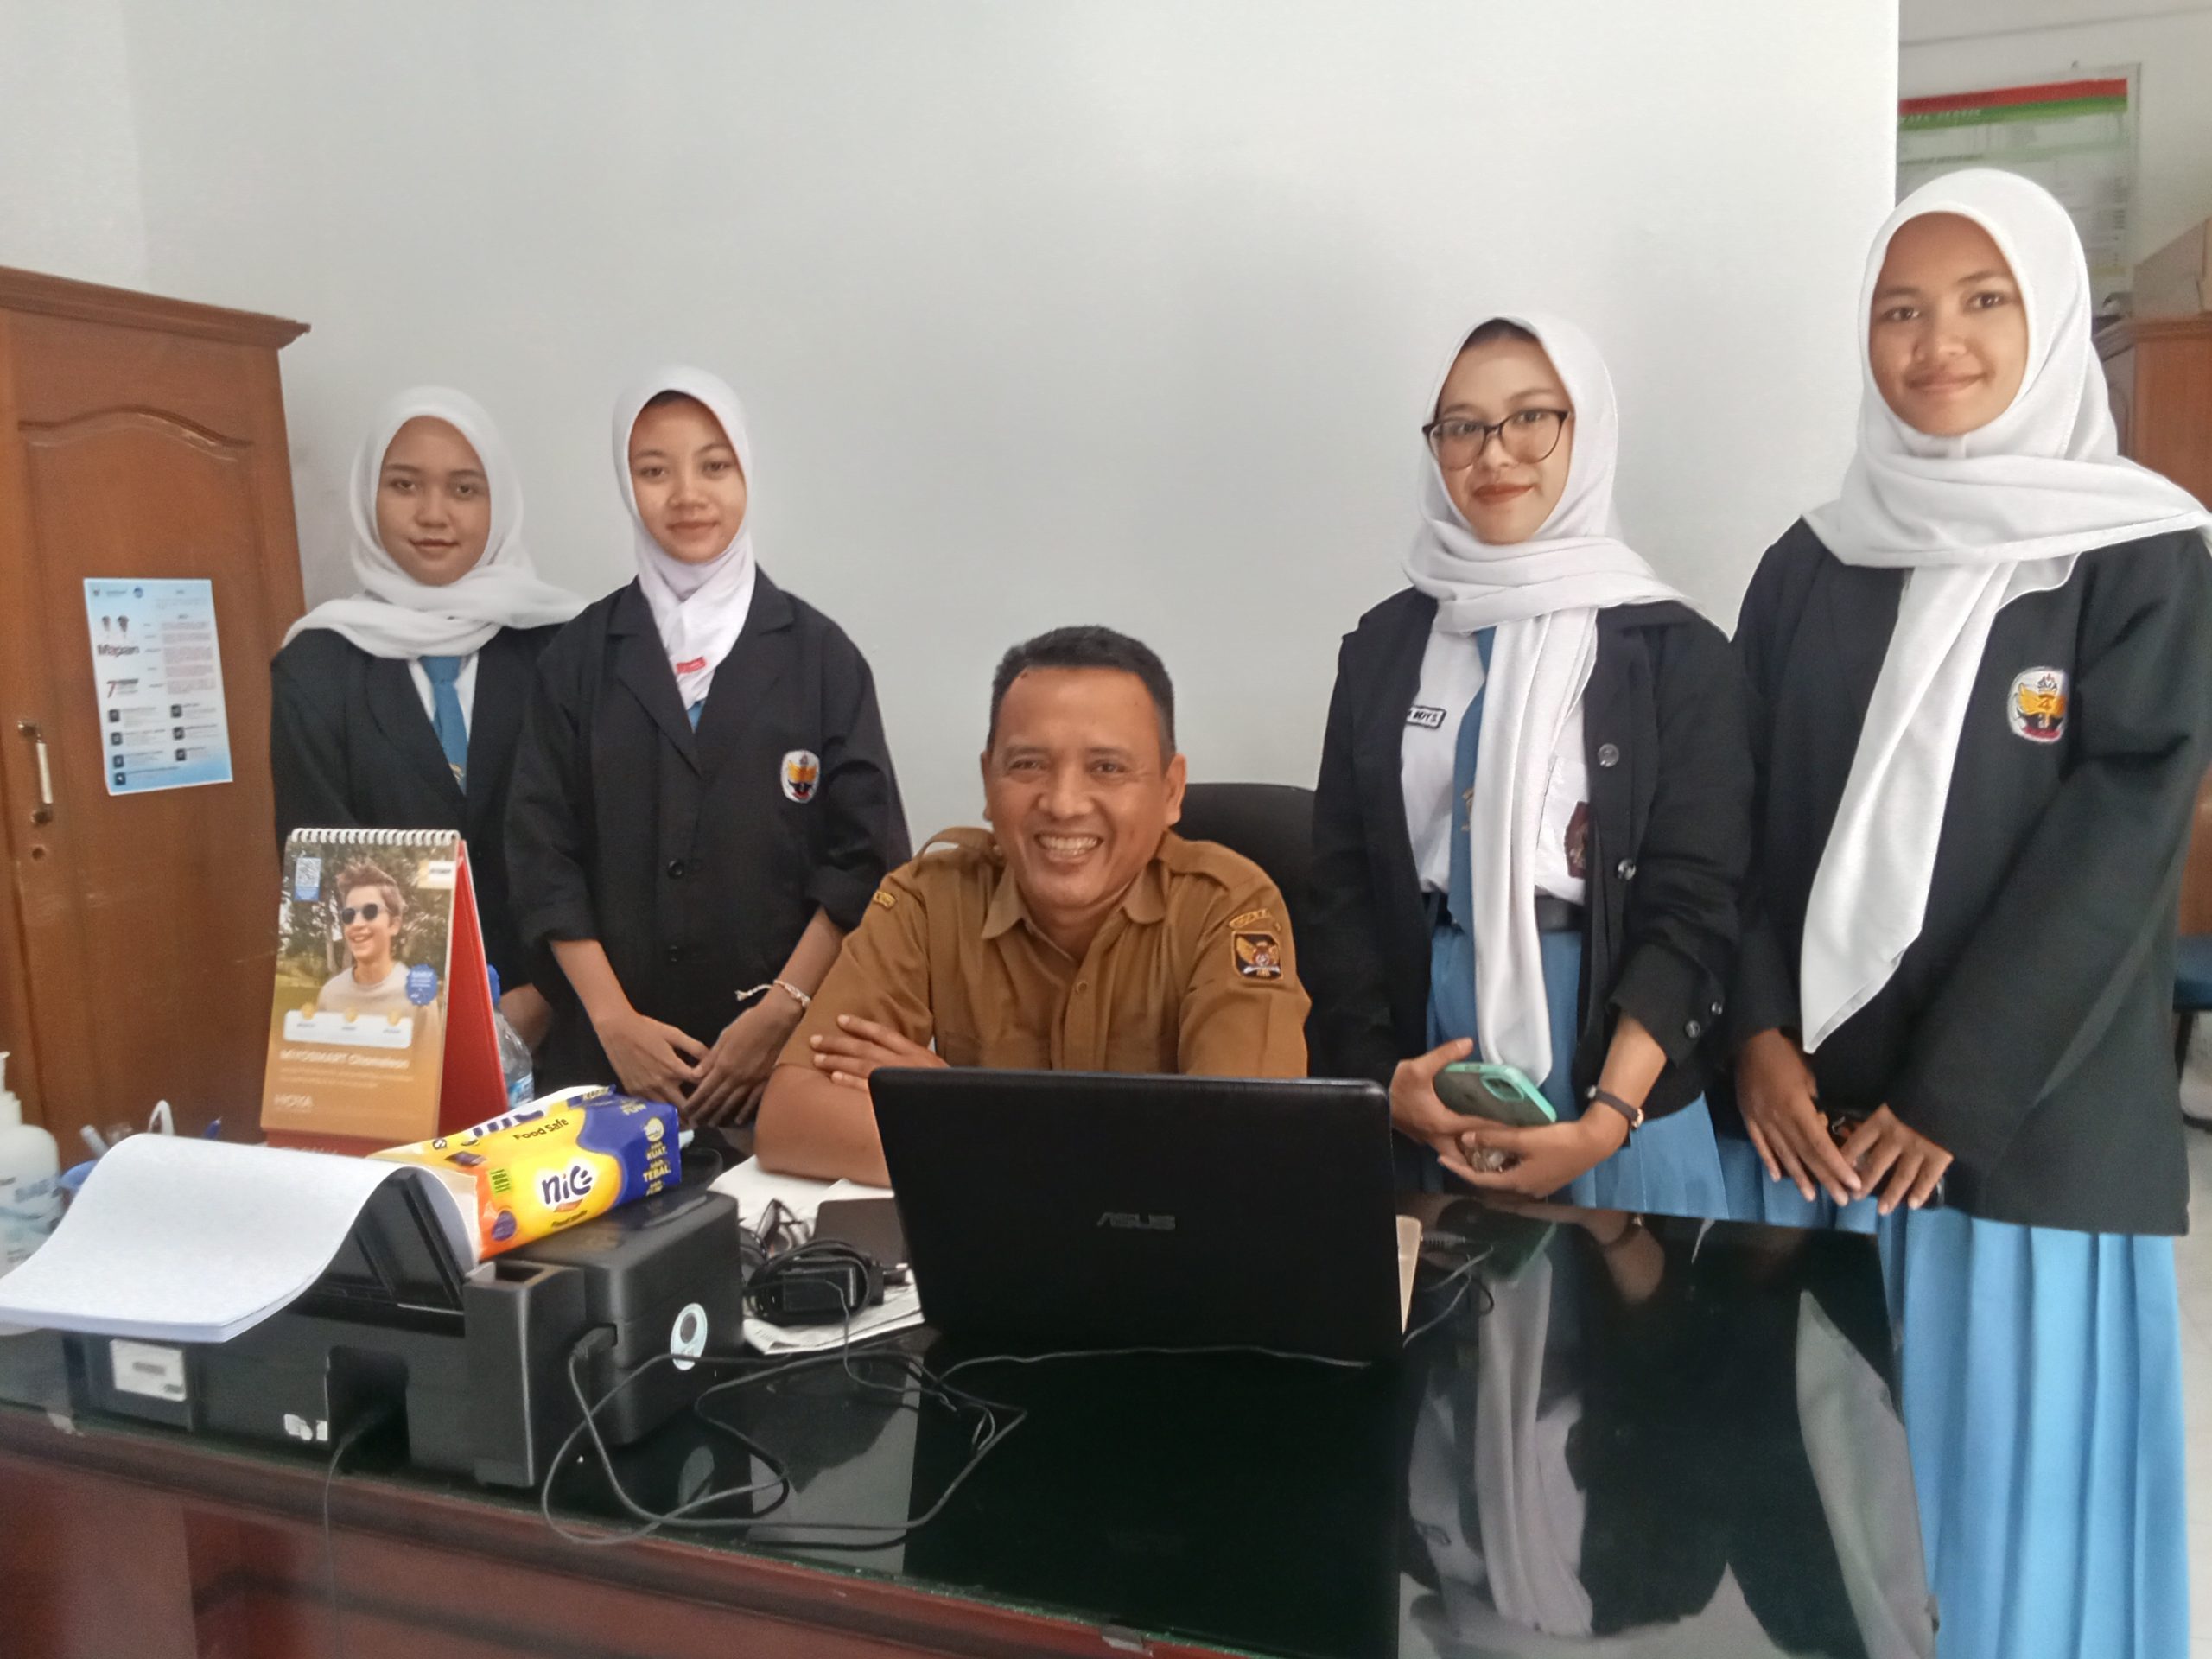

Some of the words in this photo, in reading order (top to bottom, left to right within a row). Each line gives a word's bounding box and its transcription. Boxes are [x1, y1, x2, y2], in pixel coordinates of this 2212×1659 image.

[512, 1127, 546, 1140] Food
[545, 1118, 569, 1133] Safe
[1096, 1211, 1175, 1230] ASUS
